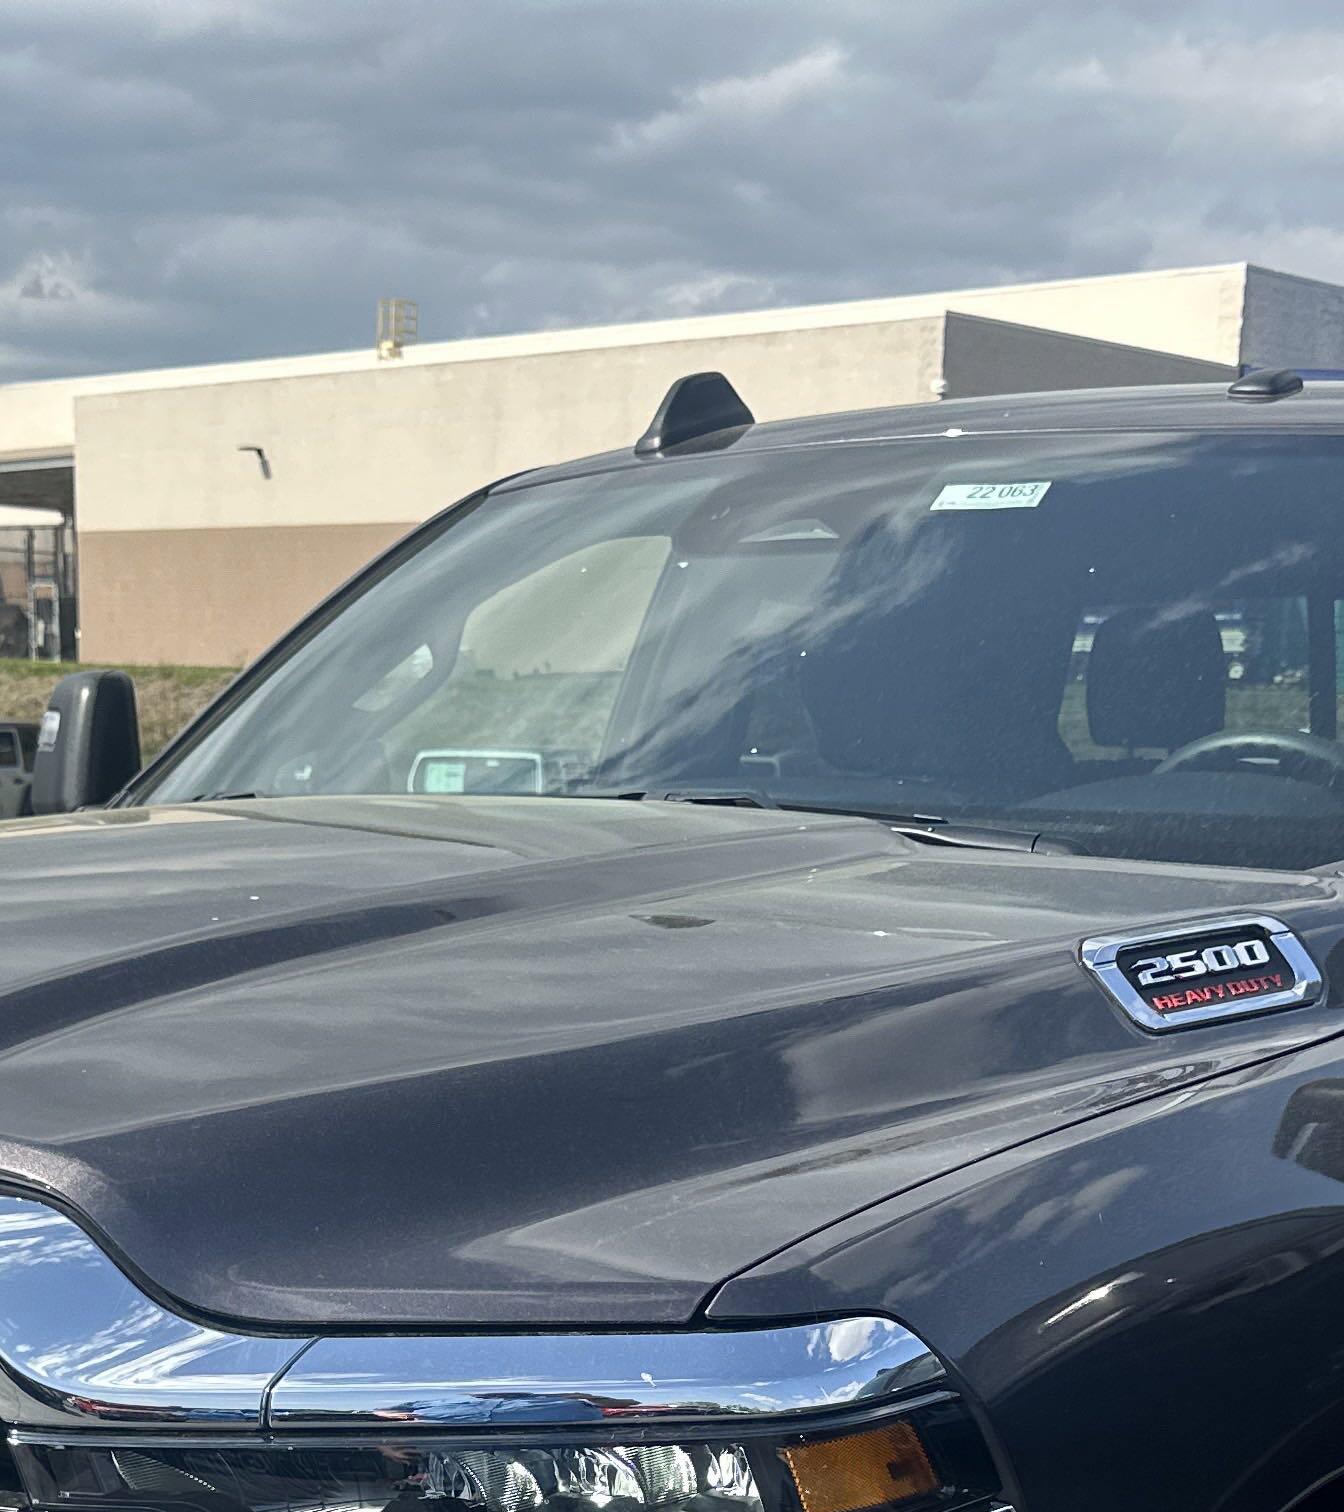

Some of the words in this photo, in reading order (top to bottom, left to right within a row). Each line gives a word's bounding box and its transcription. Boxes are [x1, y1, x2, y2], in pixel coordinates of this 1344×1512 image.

[1130, 939, 1270, 986] 2500
[1152, 983, 1226, 1010] HEAVY
[1225, 973, 1283, 996] DUTY
